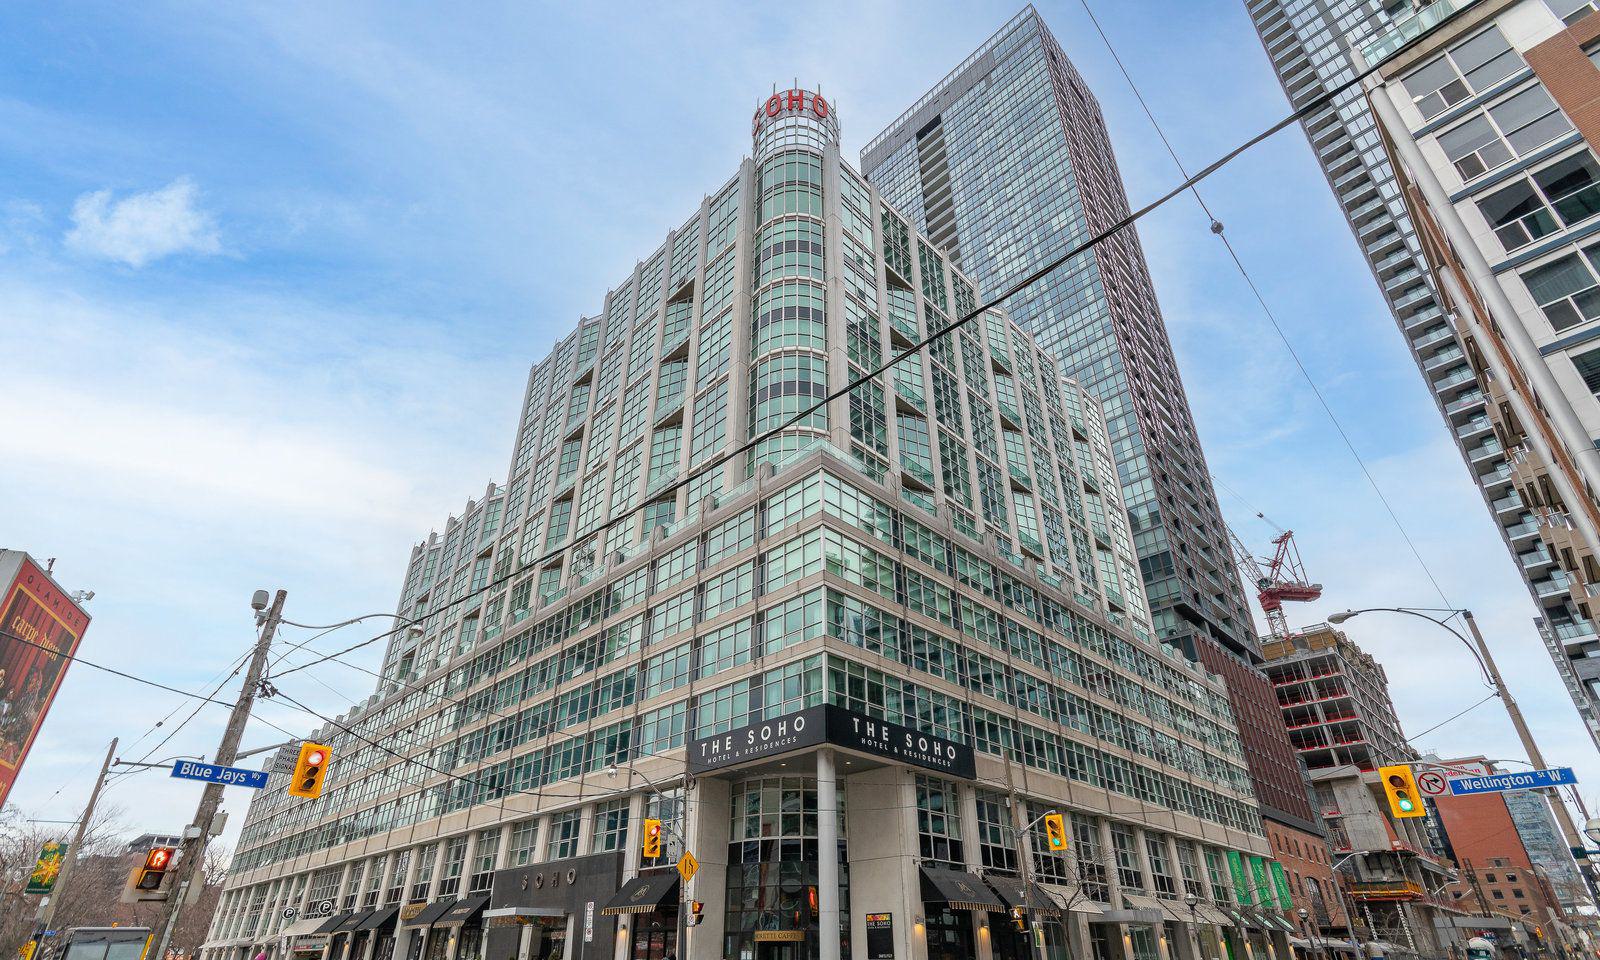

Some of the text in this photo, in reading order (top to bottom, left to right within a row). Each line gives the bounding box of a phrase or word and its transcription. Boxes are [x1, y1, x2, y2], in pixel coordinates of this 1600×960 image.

[27, 575, 81, 627] OLAMIDE
[701, 716, 805, 757] THE SOHO
[707, 753, 731, 764] HOTEL
[744, 736, 797, 755] RESIDENCES
[853, 717, 956, 759] THE SOHO
[861, 738, 888, 751] HOTEL
[903, 749, 951, 767] RESIDENCES
[180, 763, 262, 784] Blue Jays Wy
[1459, 775, 1534, 790] Wellington
[1548, 769, 1561, 782] W
[521, 868, 576, 890] SOHO
